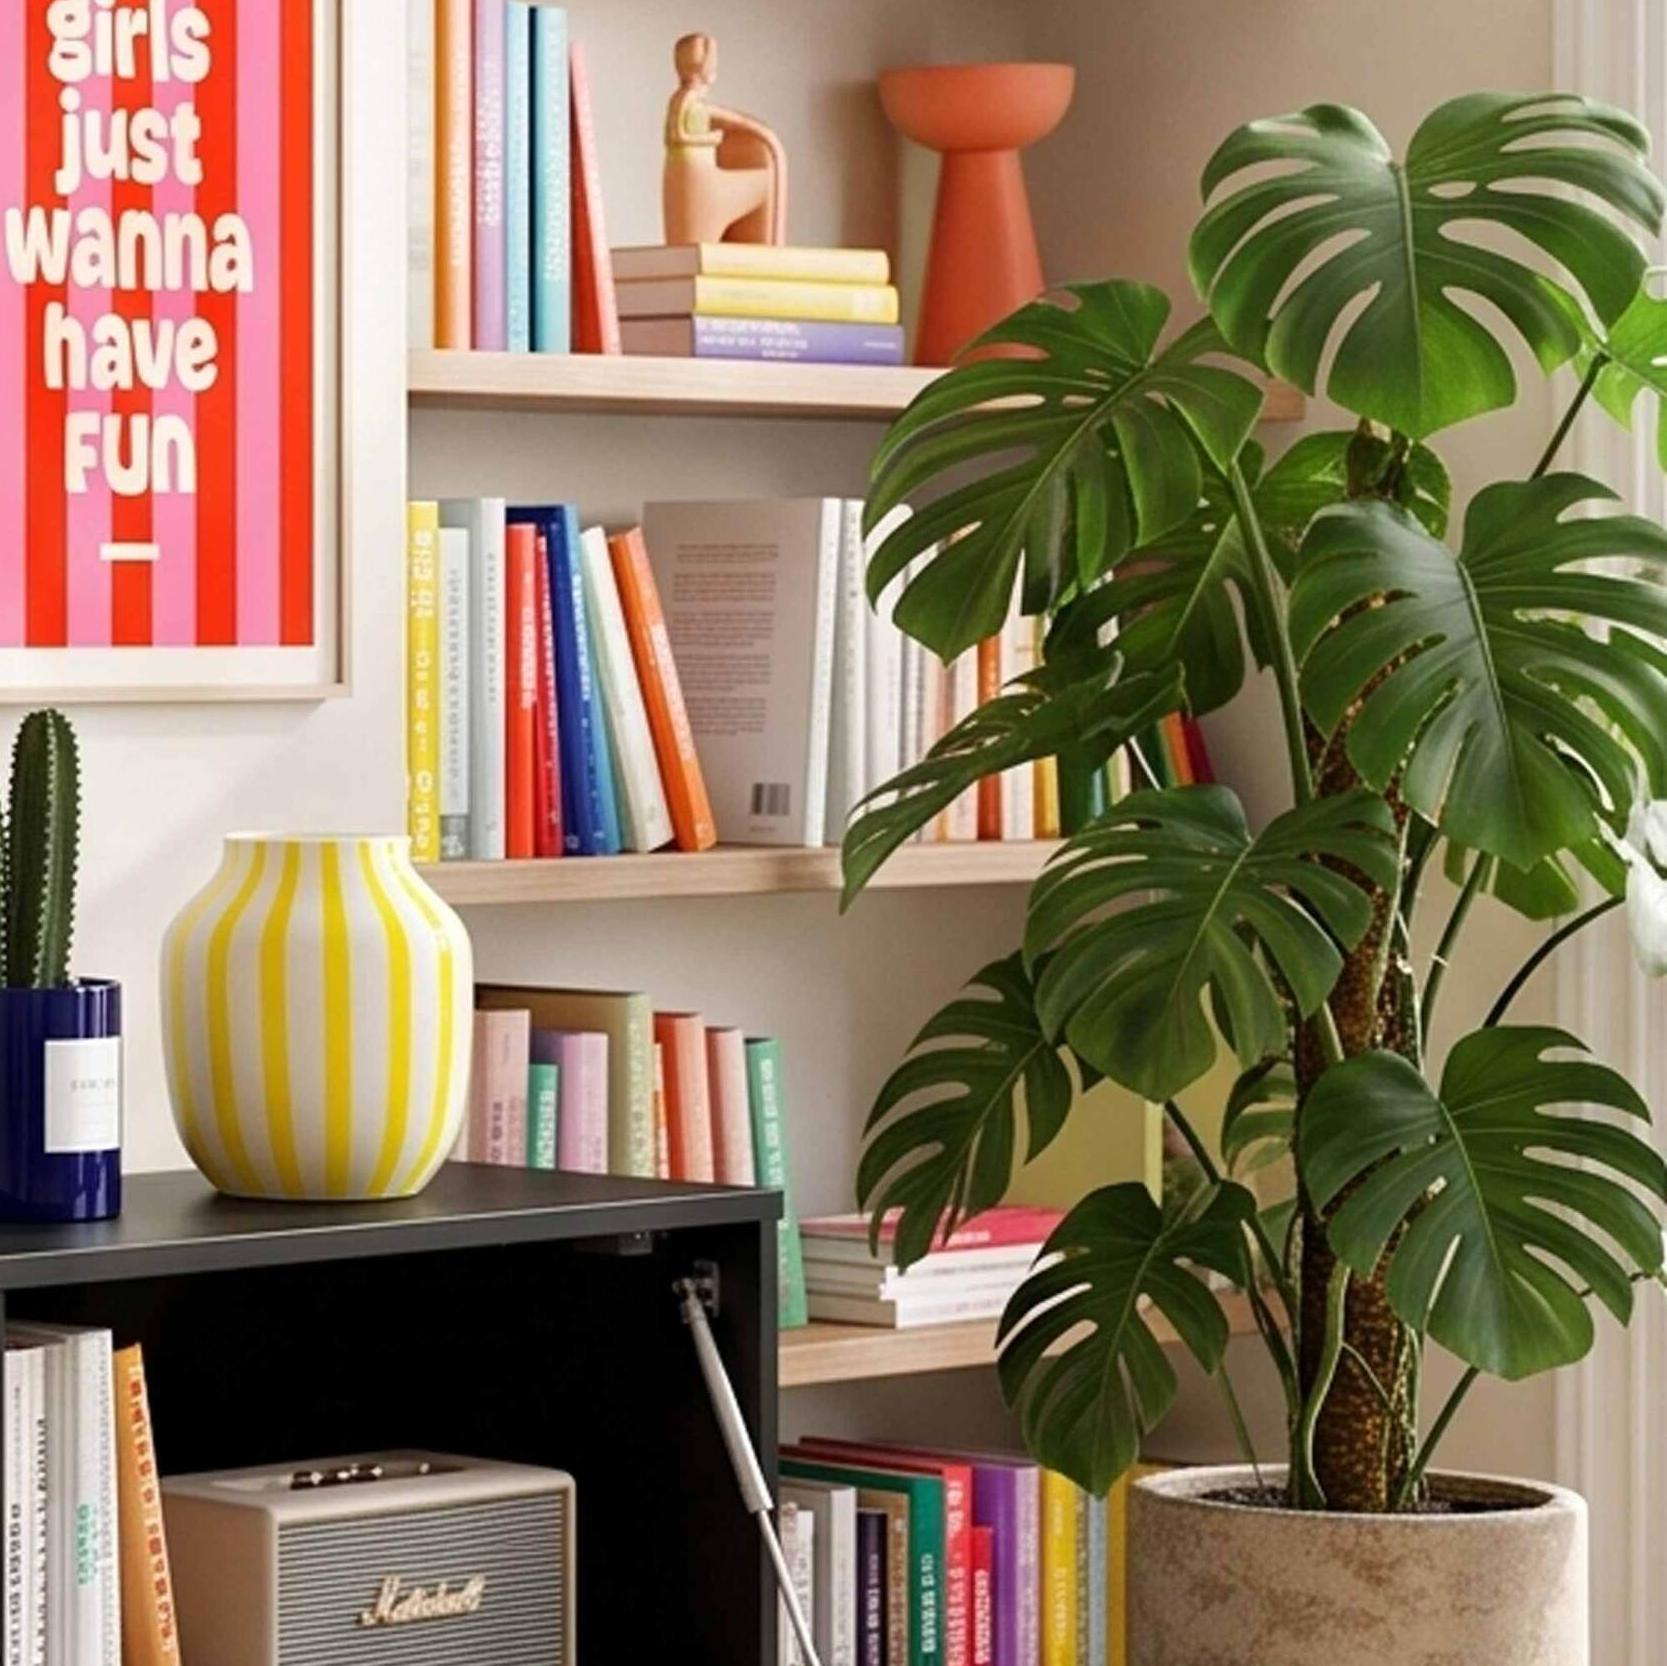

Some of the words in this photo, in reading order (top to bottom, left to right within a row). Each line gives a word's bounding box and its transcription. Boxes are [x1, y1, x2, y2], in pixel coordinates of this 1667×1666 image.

[55, 86, 203, 195] just
[4, 207, 254, 292] wanna
[44, 302, 218, 393] have
